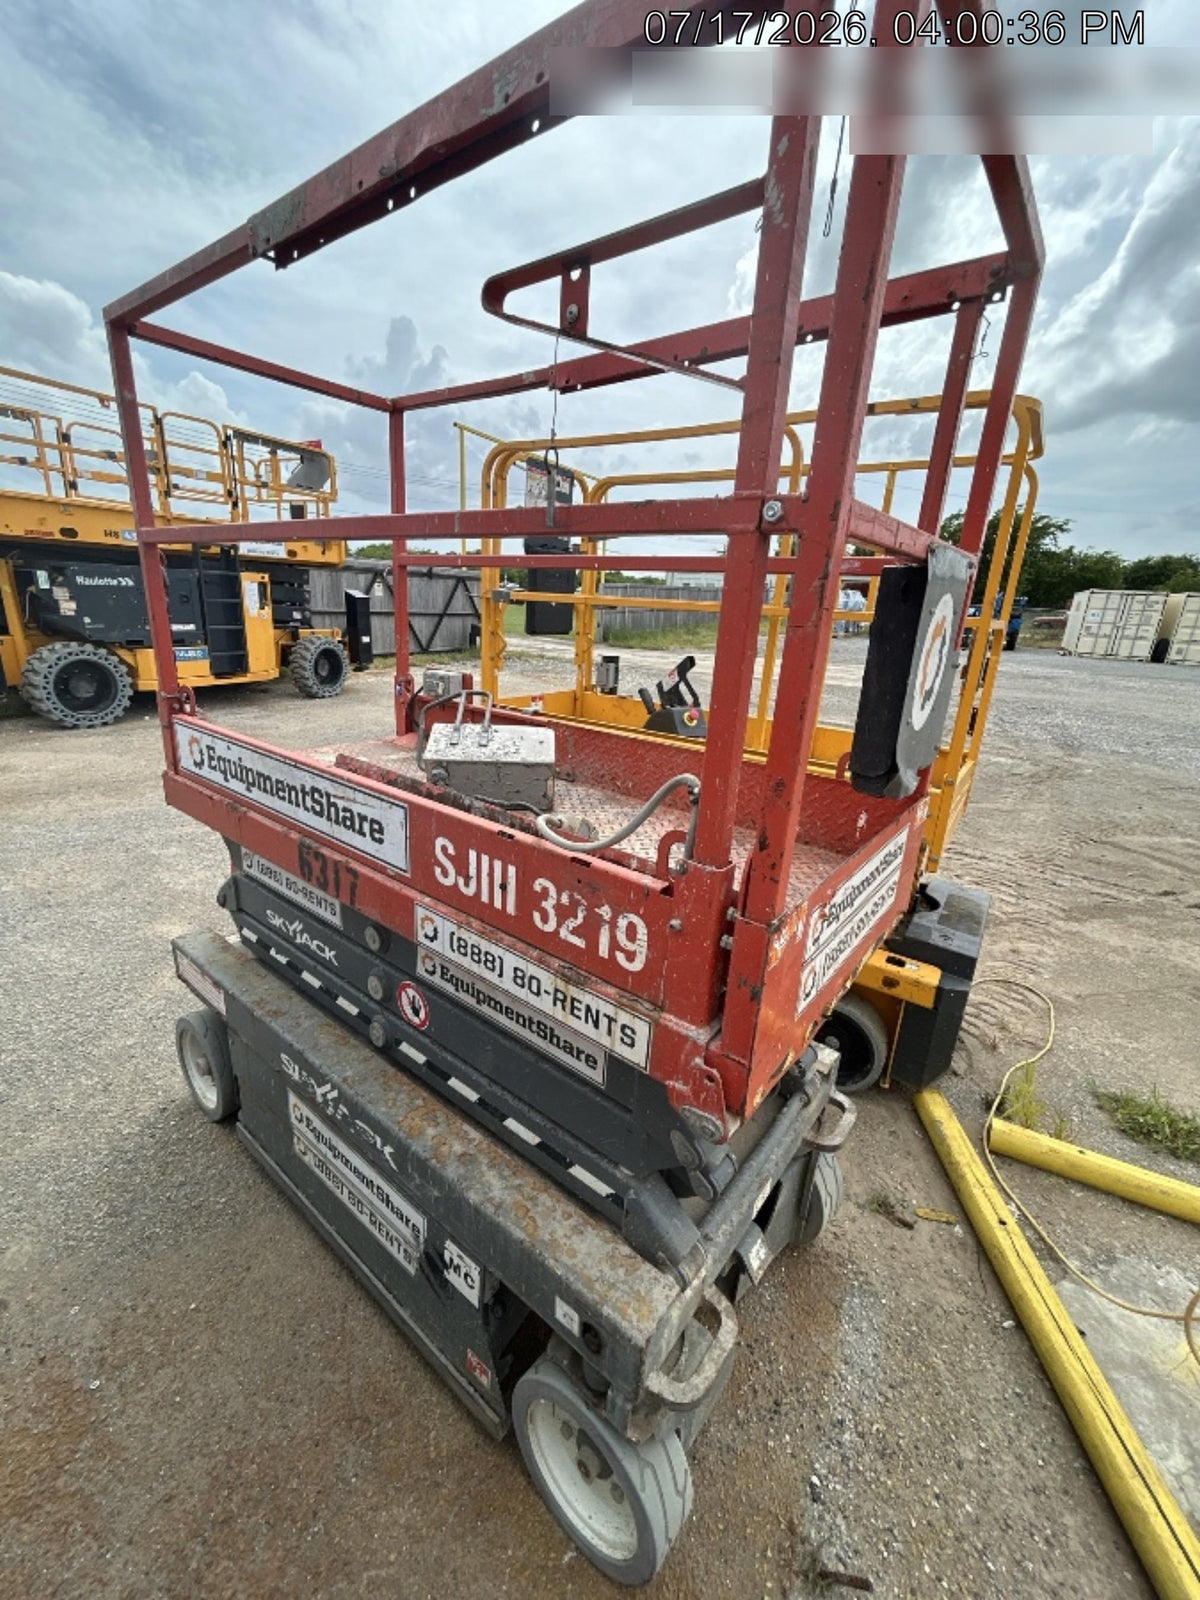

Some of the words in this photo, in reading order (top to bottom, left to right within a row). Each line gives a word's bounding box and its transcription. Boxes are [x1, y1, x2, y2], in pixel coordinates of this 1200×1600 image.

[206, 745, 385, 845] EquipmentShare
[265, 909, 338, 967] SKYJACK
[533, 877, 648, 972] 3219
[439, 962, 599, 1070] EquipmentShare
[449, 930, 504, 978] (888)
[512, 966, 637, 1050] 80-RENTS
[305, 1117, 421, 1239] EquipmentShare
